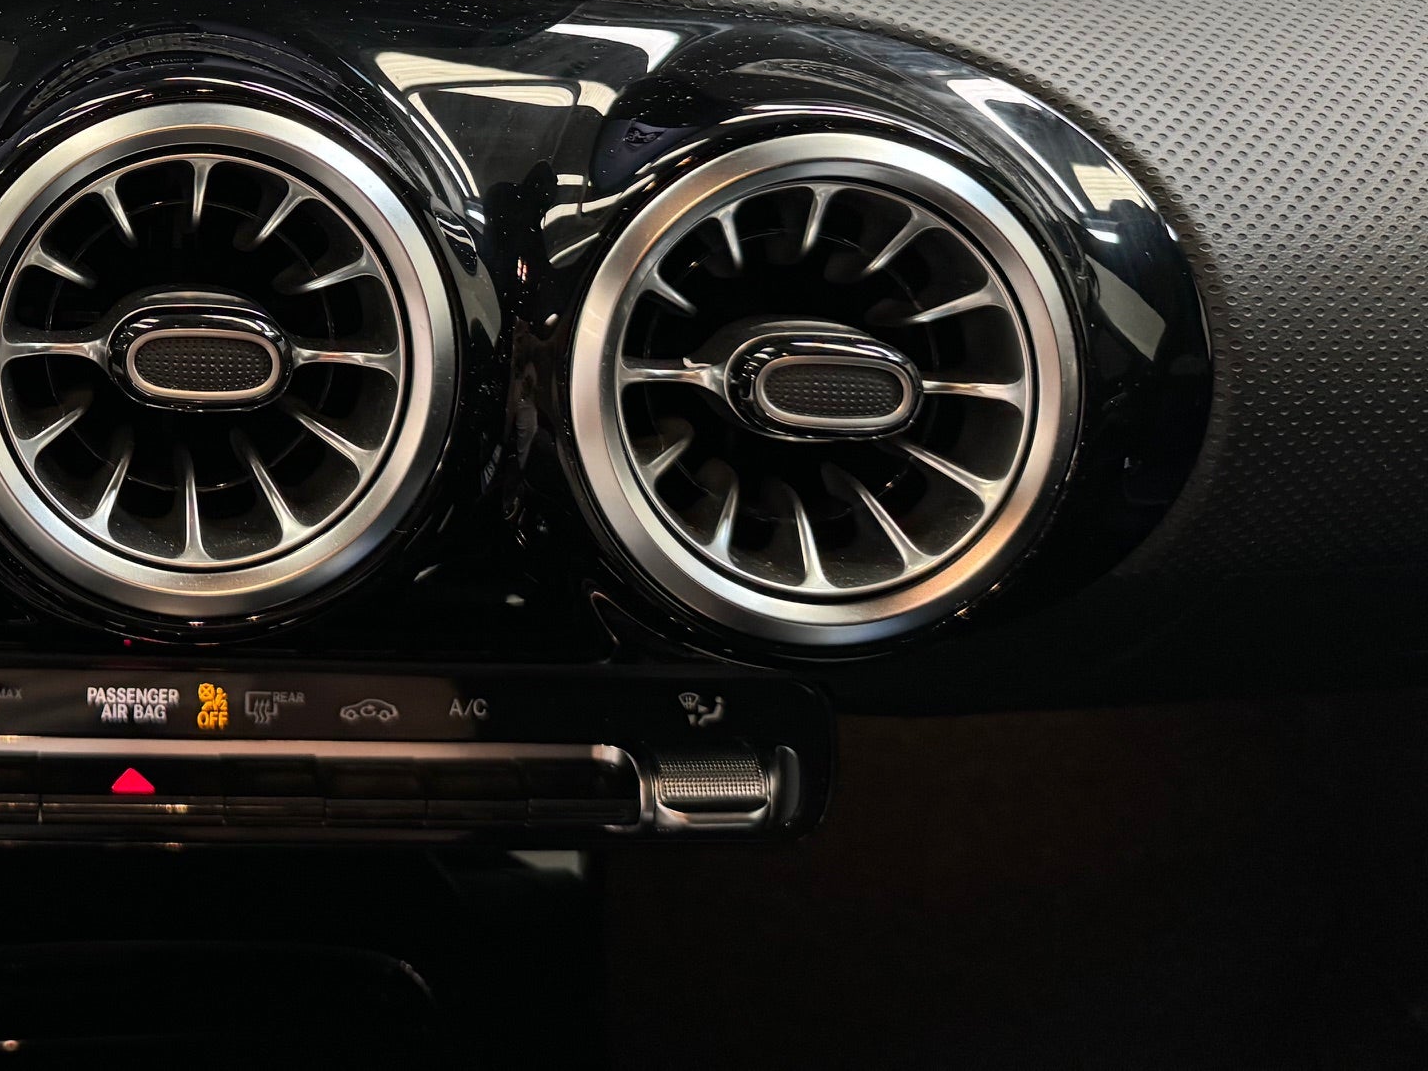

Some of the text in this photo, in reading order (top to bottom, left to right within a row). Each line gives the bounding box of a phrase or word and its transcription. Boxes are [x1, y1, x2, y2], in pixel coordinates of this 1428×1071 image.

[87, 686, 180, 705] PASSENGER
[273, 691, 305, 703] REAR
[100, 703, 167, 722] AIR BAG
[449, 698, 488, 717] A/C
[197, 710, 228, 729] OFF
